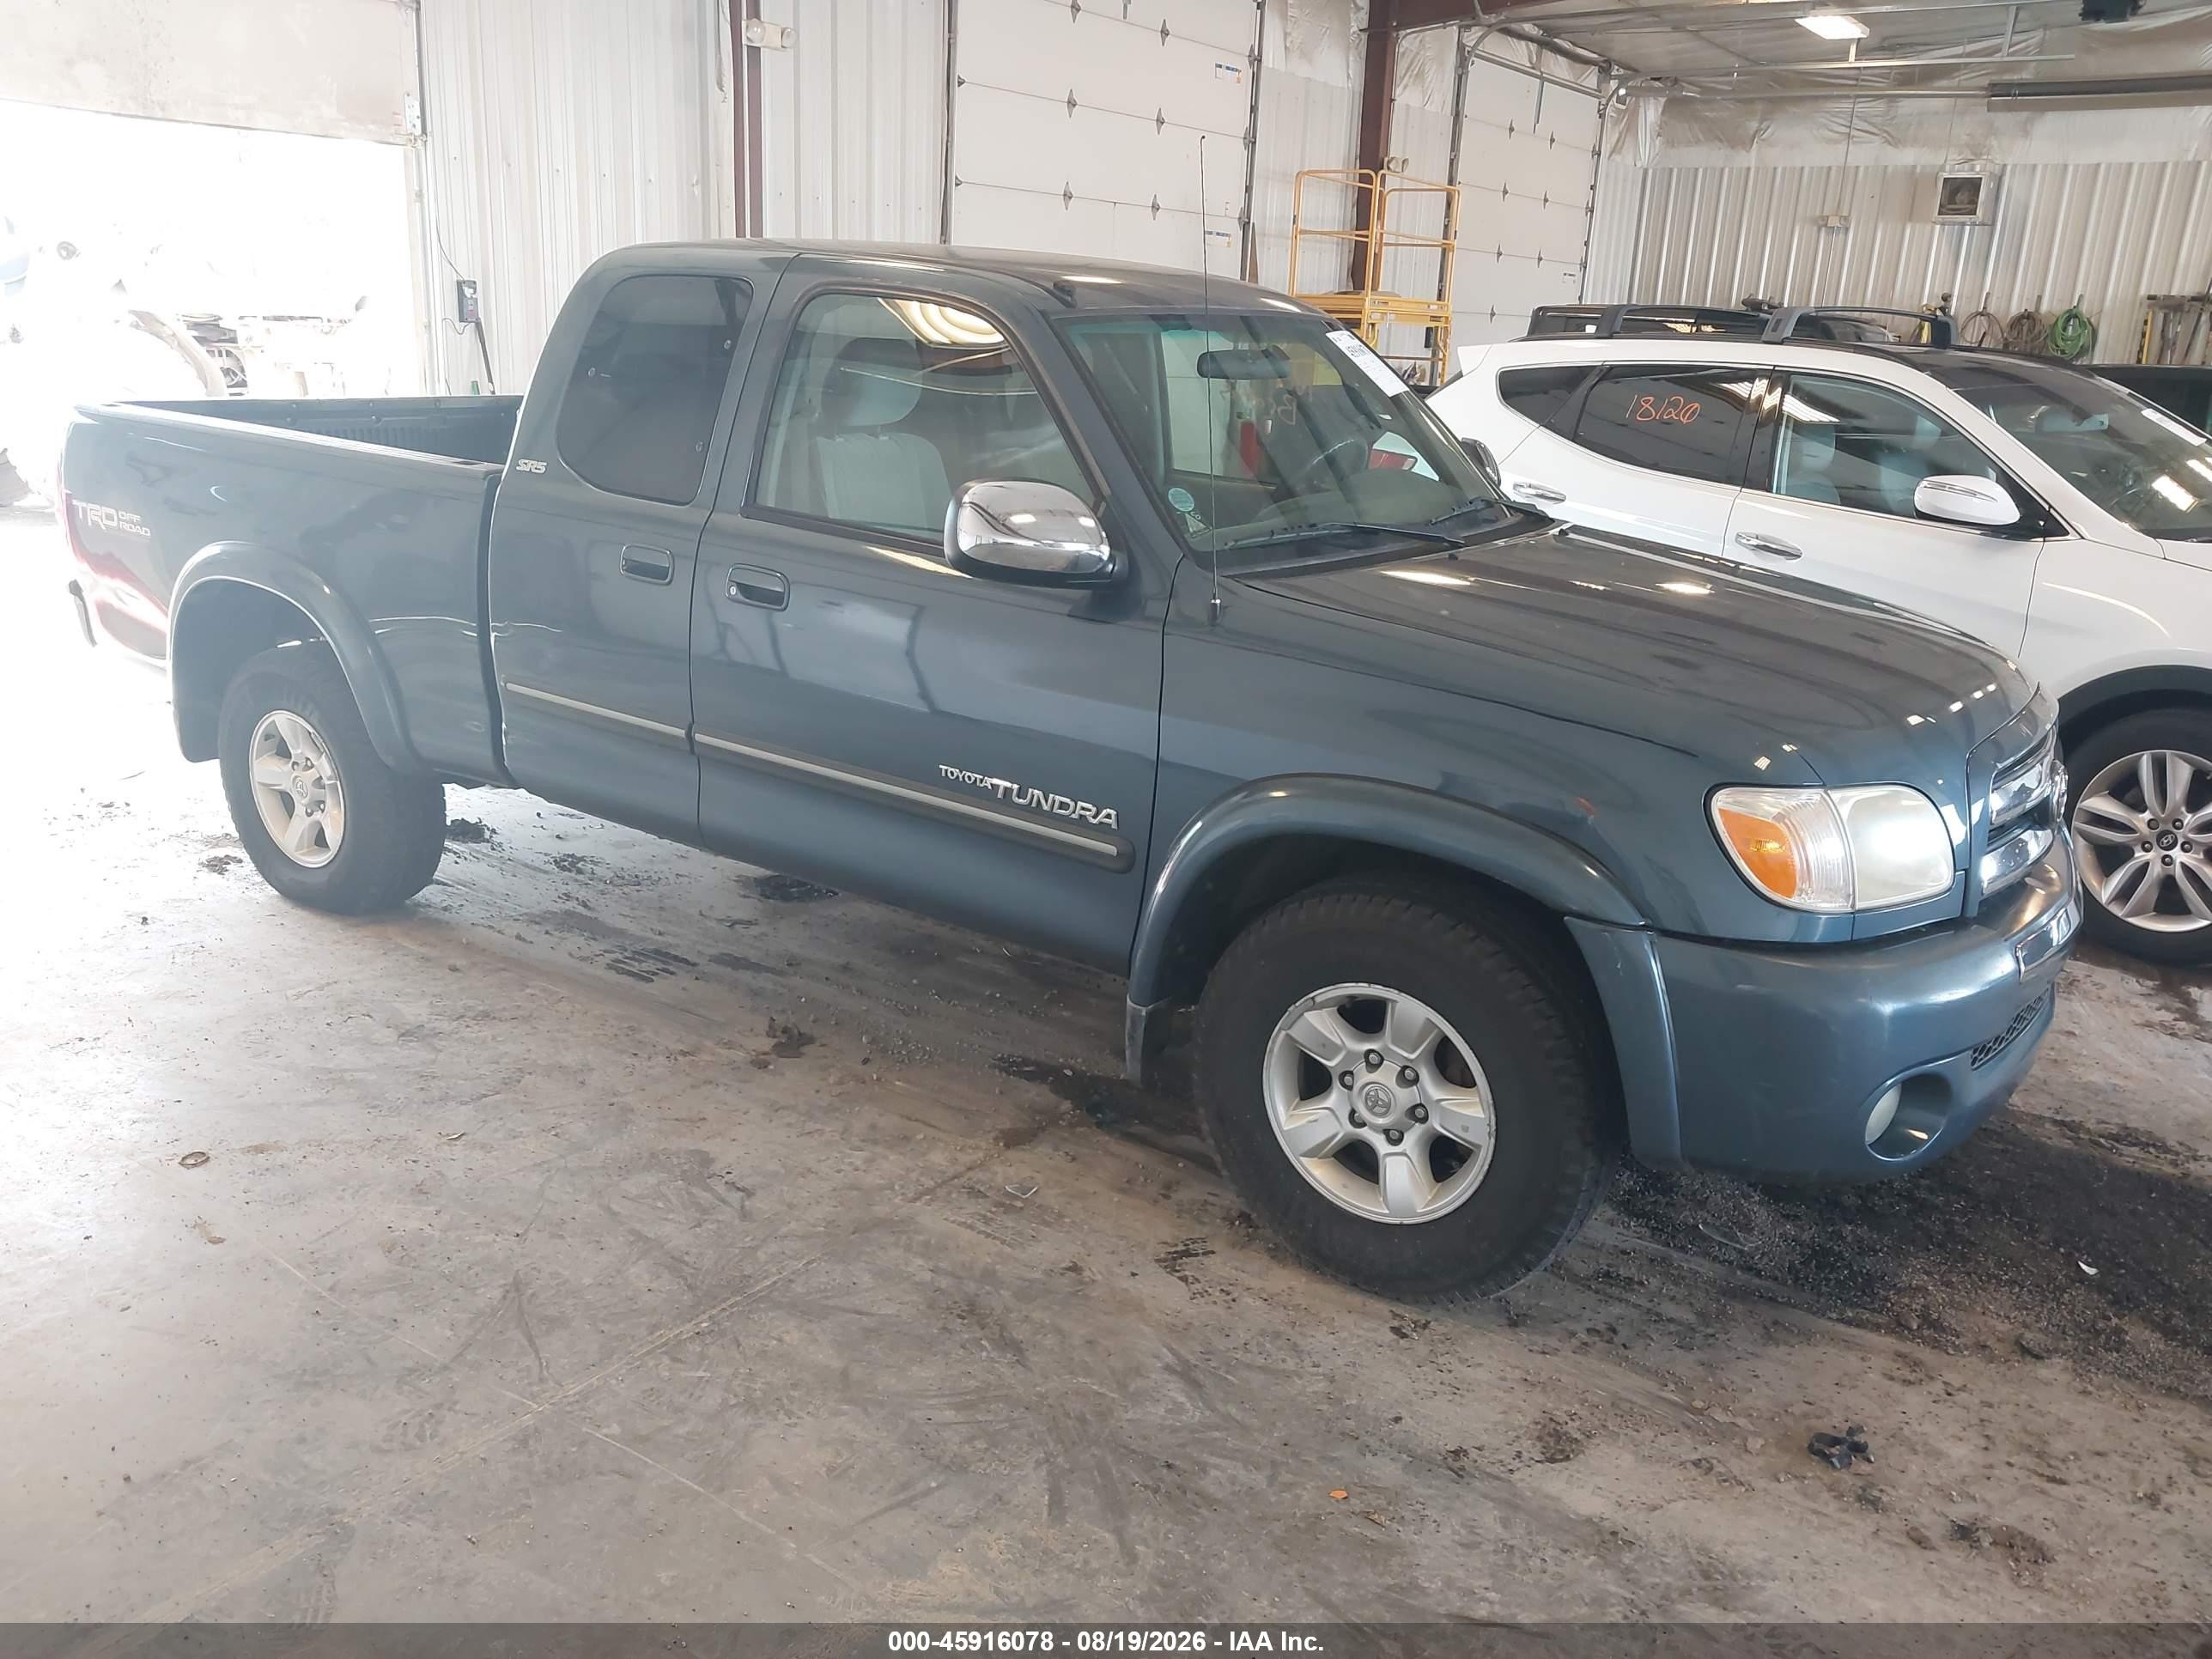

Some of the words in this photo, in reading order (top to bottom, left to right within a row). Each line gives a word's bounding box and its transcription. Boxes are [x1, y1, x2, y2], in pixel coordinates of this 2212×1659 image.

[1626, 394, 1701, 424] 18120
[516, 459, 547, 473] SR5
[72, 499, 118, 529] TRD
[118, 510, 143, 523] OFF
[119, 520, 151, 537] ROAD
[939, 764, 993, 790] TOYOTA
[988, 777, 1119, 830] TUNDRA
